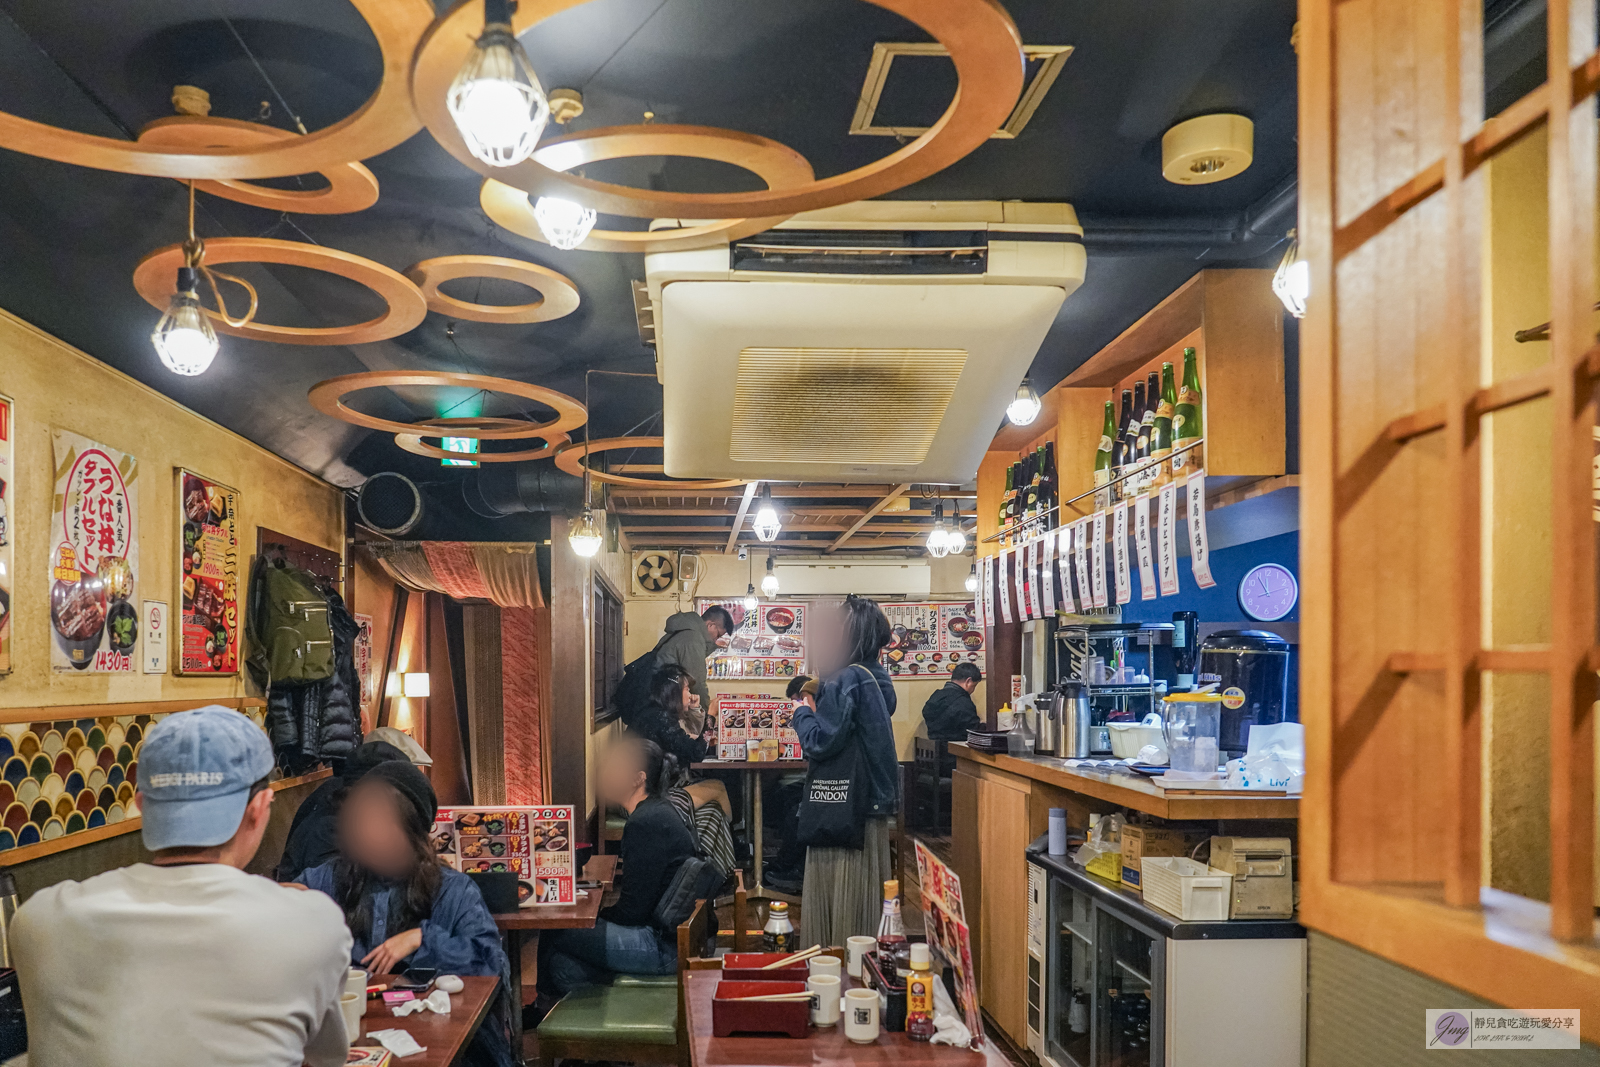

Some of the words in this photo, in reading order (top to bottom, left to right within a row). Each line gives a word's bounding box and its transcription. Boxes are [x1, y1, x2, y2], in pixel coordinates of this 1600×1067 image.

[82, 459, 97, 565] ダブルセット
[98, 468, 115, 553] うな丼
[810, 791, 847, 800] LONDON
[549, 879, 558, 901] 生ビール
